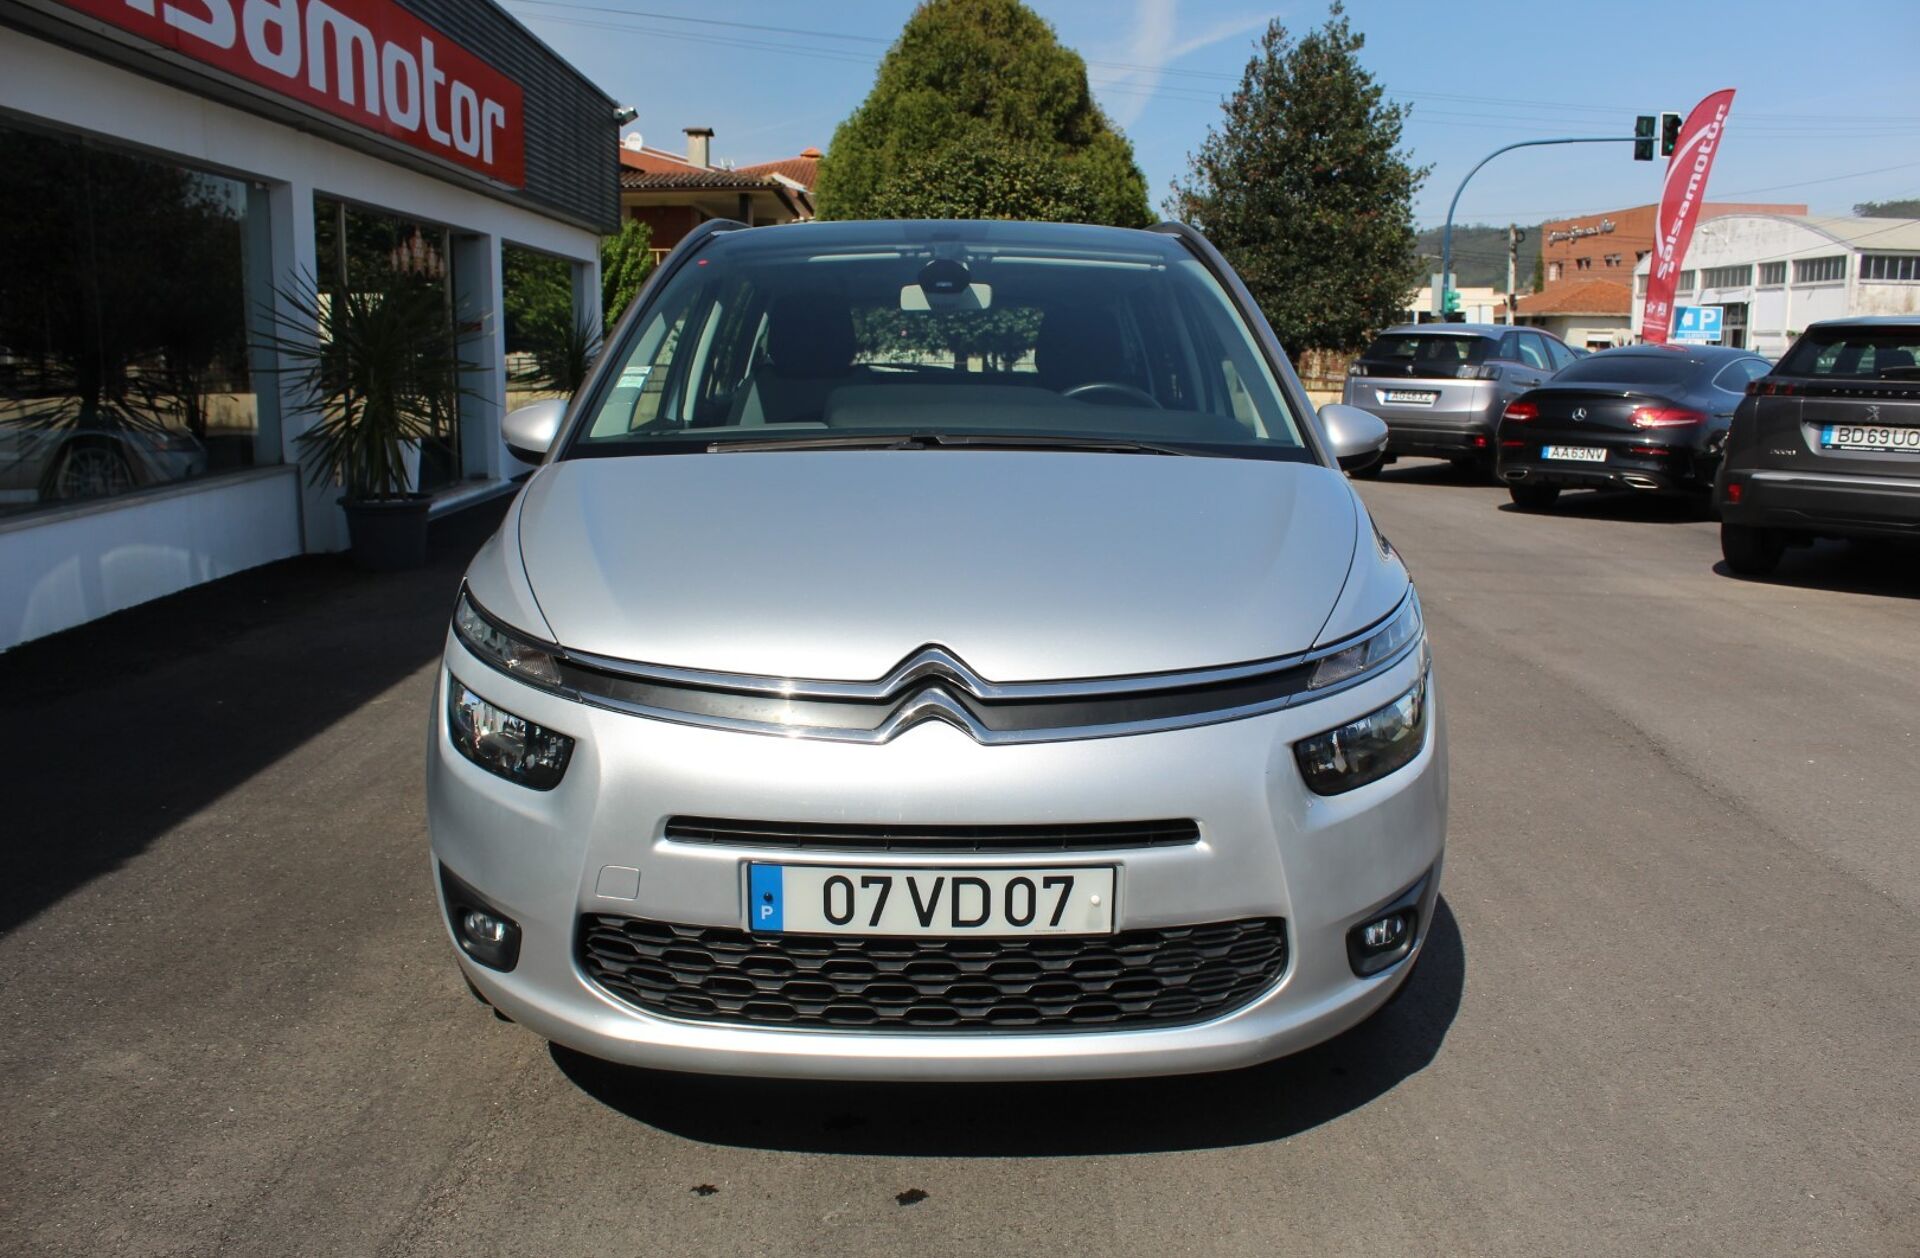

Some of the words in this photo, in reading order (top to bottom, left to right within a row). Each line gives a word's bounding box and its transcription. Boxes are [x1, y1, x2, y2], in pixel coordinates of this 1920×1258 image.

[125, 0, 505, 165] amotor
[1699, 309, 1717, 330] P
[1552, 447, 1605, 459] AA63NV
[761, 904, 773, 920] P
[823, 875, 1074, 928] 07VD07
